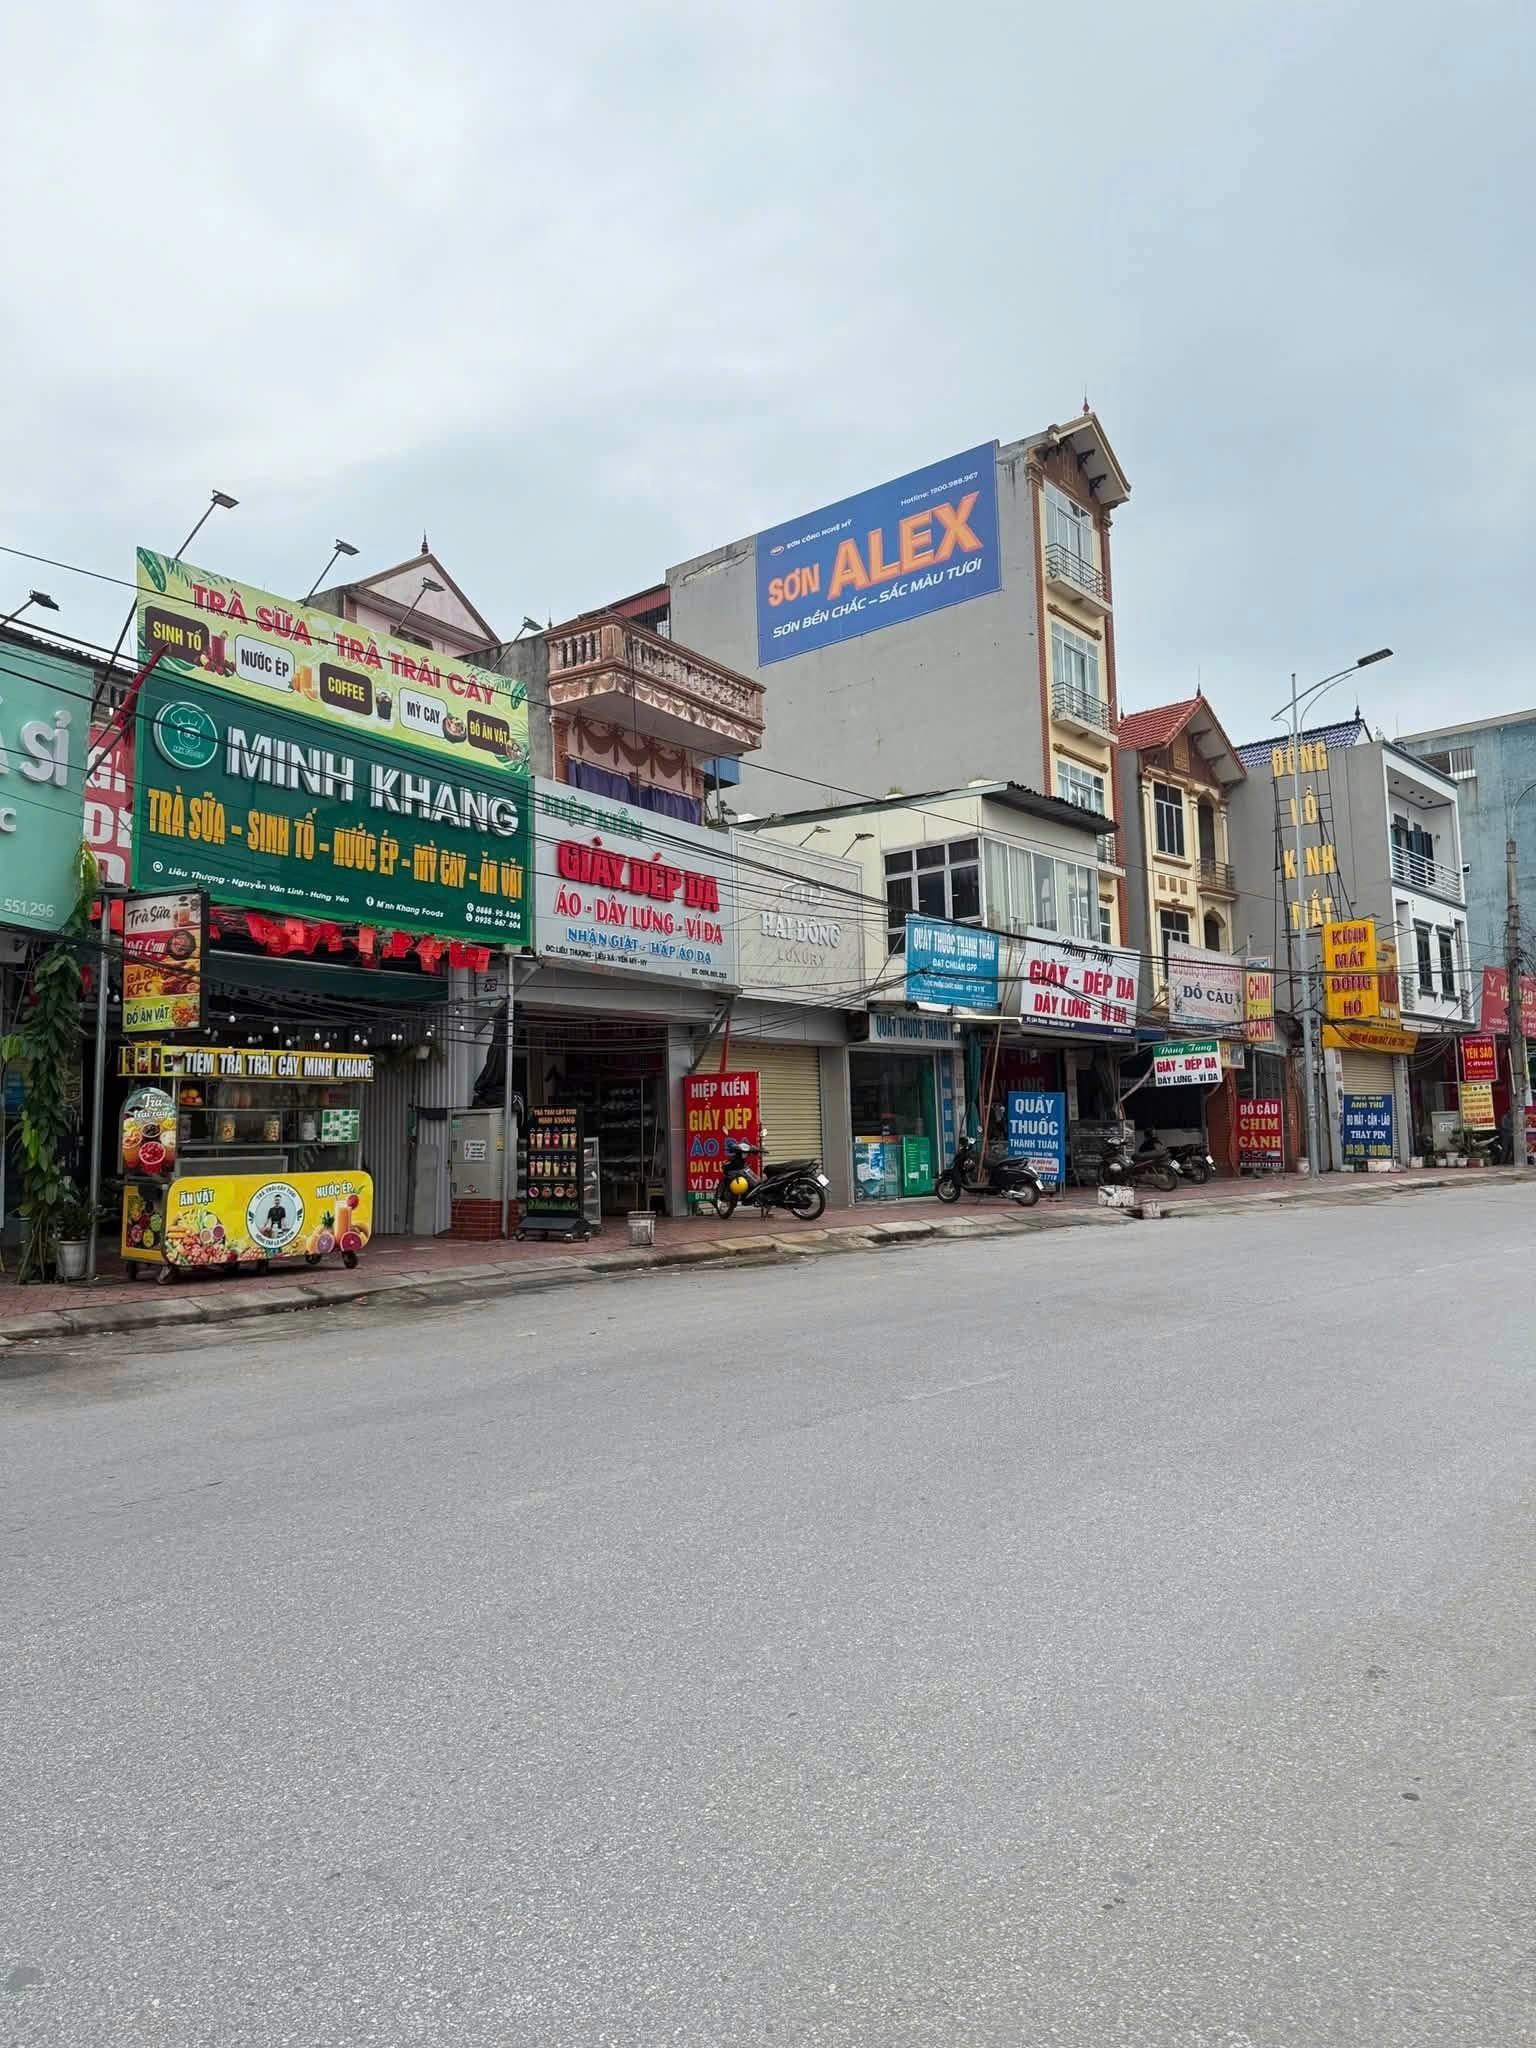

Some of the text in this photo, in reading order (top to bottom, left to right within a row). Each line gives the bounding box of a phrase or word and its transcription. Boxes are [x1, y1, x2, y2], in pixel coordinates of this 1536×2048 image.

[768, 491, 984, 608] SƠN ALEX
[773, 619, 800, 639] SƠN
[831, 597, 866, 619] CHẮC
[879, 584, 908, 604] SẮC
[910, 572, 943, 593] MÀU
[946, 558, 982, 580] TƯƠI
[152, 621, 202, 651] SINH TỐ
[191, 584, 496, 705] TRÀ SỮA TRÀ TRÁI CÂY
[241, 648, 289, 677] NƯỚC ÉP
[327, 676, 365, 702] COFFEE
[407, 699, 441, 725] MỲ CAY
[469, 720, 480, 737] ĐỒ
[226, 726, 519, 837] MINH KHANG
[148, 785, 185, 837] TRÀ
[188, 791, 225, 845] SỮA
[248, 809, 289, 856] SINH
[294, 807, 318, 860] TỐ
[333, 822, 376, 872] NƯỚC
[379, 829, 399, 876] ÉP
[414, 840, 437, 883] MỲ
[440, 850, 467, 888] CAY
[480, 851, 498, 895] ĂN
[501, 857, 524, 903] VẬT
[1283, 843, 1336, 880] KNH
[556, 836, 626, 889] GIÀY
[628, 852, 682, 903] DÉP
[684, 871, 721, 912] DA
[191, 871, 225, 885] Thượng
[231, 878, 267, 890] Nguyễn
[269, 884, 285, 893] Văn
[287, 887, 304, 896] Linh
[310, 892, 332, 902] Hưng
[335, 895, 350, 903] Yên
[128, 904, 171, 928] Trà Sữa
[396, 904, 420, 915] Khang
[422, 907, 444, 918] Foods
[554, 884, 723, 945] ÁO DÂY LƯNG VÍ DA
[567, 927, 607, 949] NHẬN
[678, 945, 695, 961] ÁO
[777, 947, 825, 966] LUXURY
[1334, 946, 1366, 969] MẮT
[127, 981, 152, 998] KFC
[1029, 958, 1135, 1000] GIÀY DÉP DA
[1248, 976, 1269, 1000] CHIM
[1034, 991, 1059, 1014] DÂY
[1061, 997, 1091, 1019] LƯNG
[1183, 982, 1233, 1005] ĐỒ CÂU
[126, 1002, 170, 1025] ĐỒ ĂN VẬT
[219, 1050, 242, 1074] TRÀ
[246, 1050, 273, 1076] TRÁI
[277, 1053, 299, 1077] CÂY
[303, 1056, 332, 1077] MINH
[336, 1058, 374, 1078] KHANG
[1157, 1056, 1217, 1073] GIÀY DÉP DA
[1208, 1073, 1218, 1081] DA
[691, 1080, 718, 1101] HIỆP
[724, 1103, 752, 1131] DÉP
[1256, 1101, 1278, 1115] CÂU
[1010, 1116, 1059, 1136] THUỐC
[1240, 1118, 1279, 1130] CHIM
[1350, 1130, 1386, 1139] THAY PIN
[1010, 1138, 1036, 1149] THANH
[1239, 1131, 1281, 1148] CẢNH
[179, 1187, 215, 1207] ĂN VẬT
[315, 1181, 353, 1199] NƯỚC ÉP
